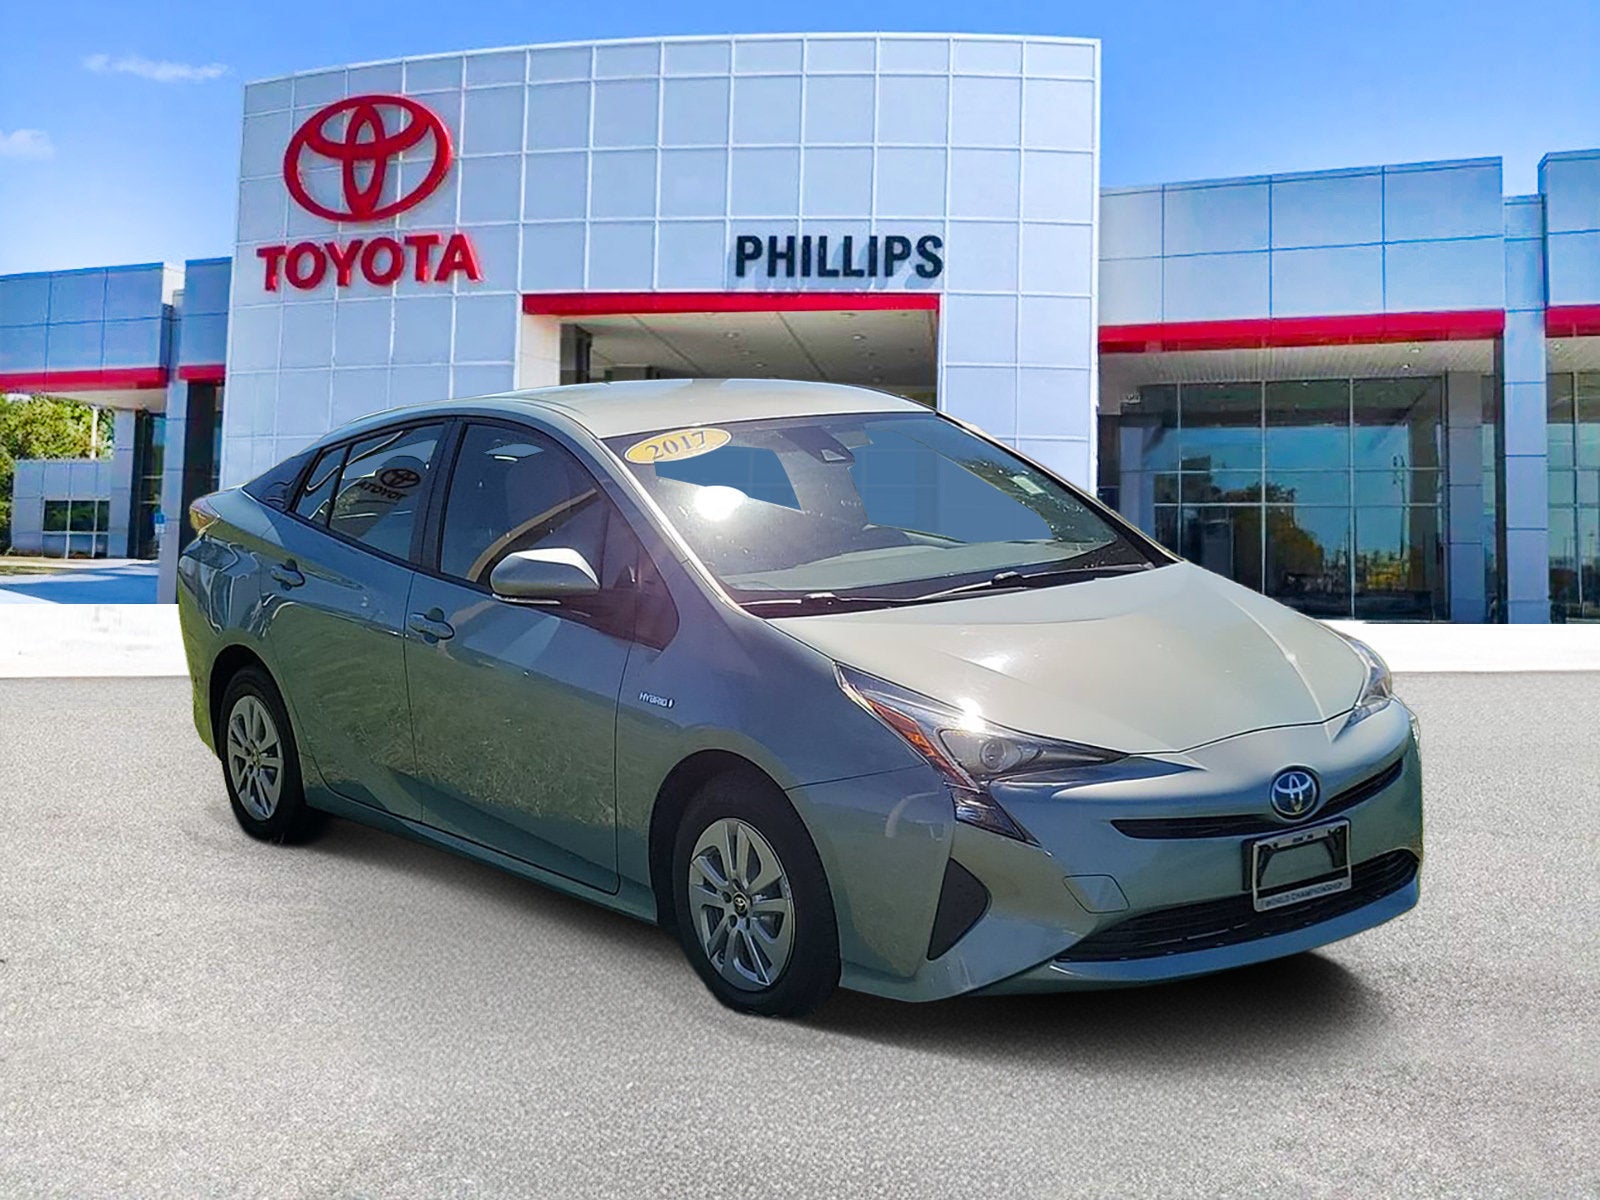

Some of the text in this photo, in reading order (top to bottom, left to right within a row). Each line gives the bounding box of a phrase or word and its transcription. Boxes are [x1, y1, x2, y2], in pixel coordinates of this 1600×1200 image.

[256, 233, 481, 292] TOYOTA
[735, 235, 944, 279] PHILLIPS
[645, 430, 707, 460] 2017
[638, 691, 668, 707] HYBRID
